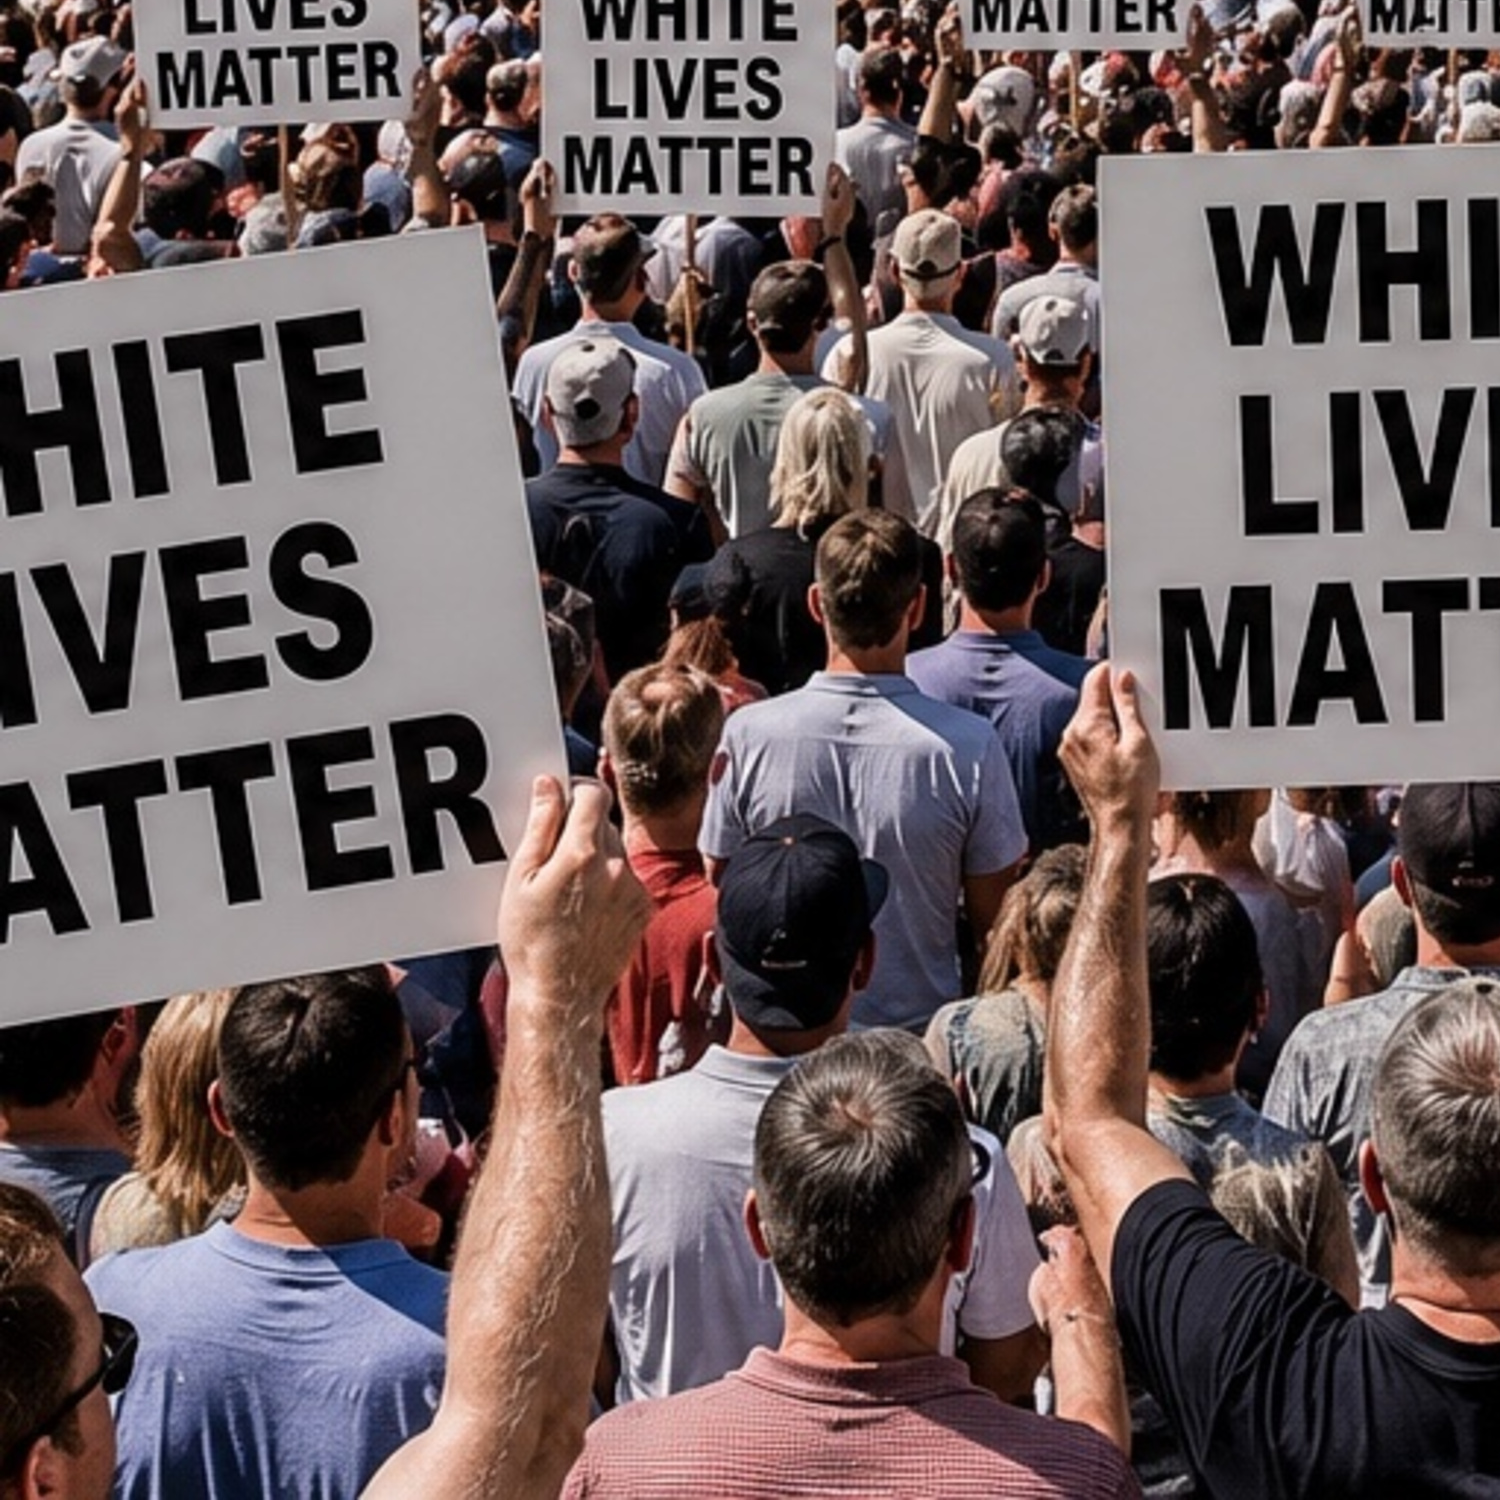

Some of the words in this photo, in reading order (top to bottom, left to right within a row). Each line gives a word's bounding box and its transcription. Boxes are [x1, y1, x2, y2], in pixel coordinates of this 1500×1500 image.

[157, 41, 401, 110] MATTER
[595, 57, 782, 120] LIVES
[564, 136, 814, 196] MATTER
[0, 309, 384, 517] HITE
[0, 522, 373, 729] IVES
[0, 714, 507, 944] ATTER
